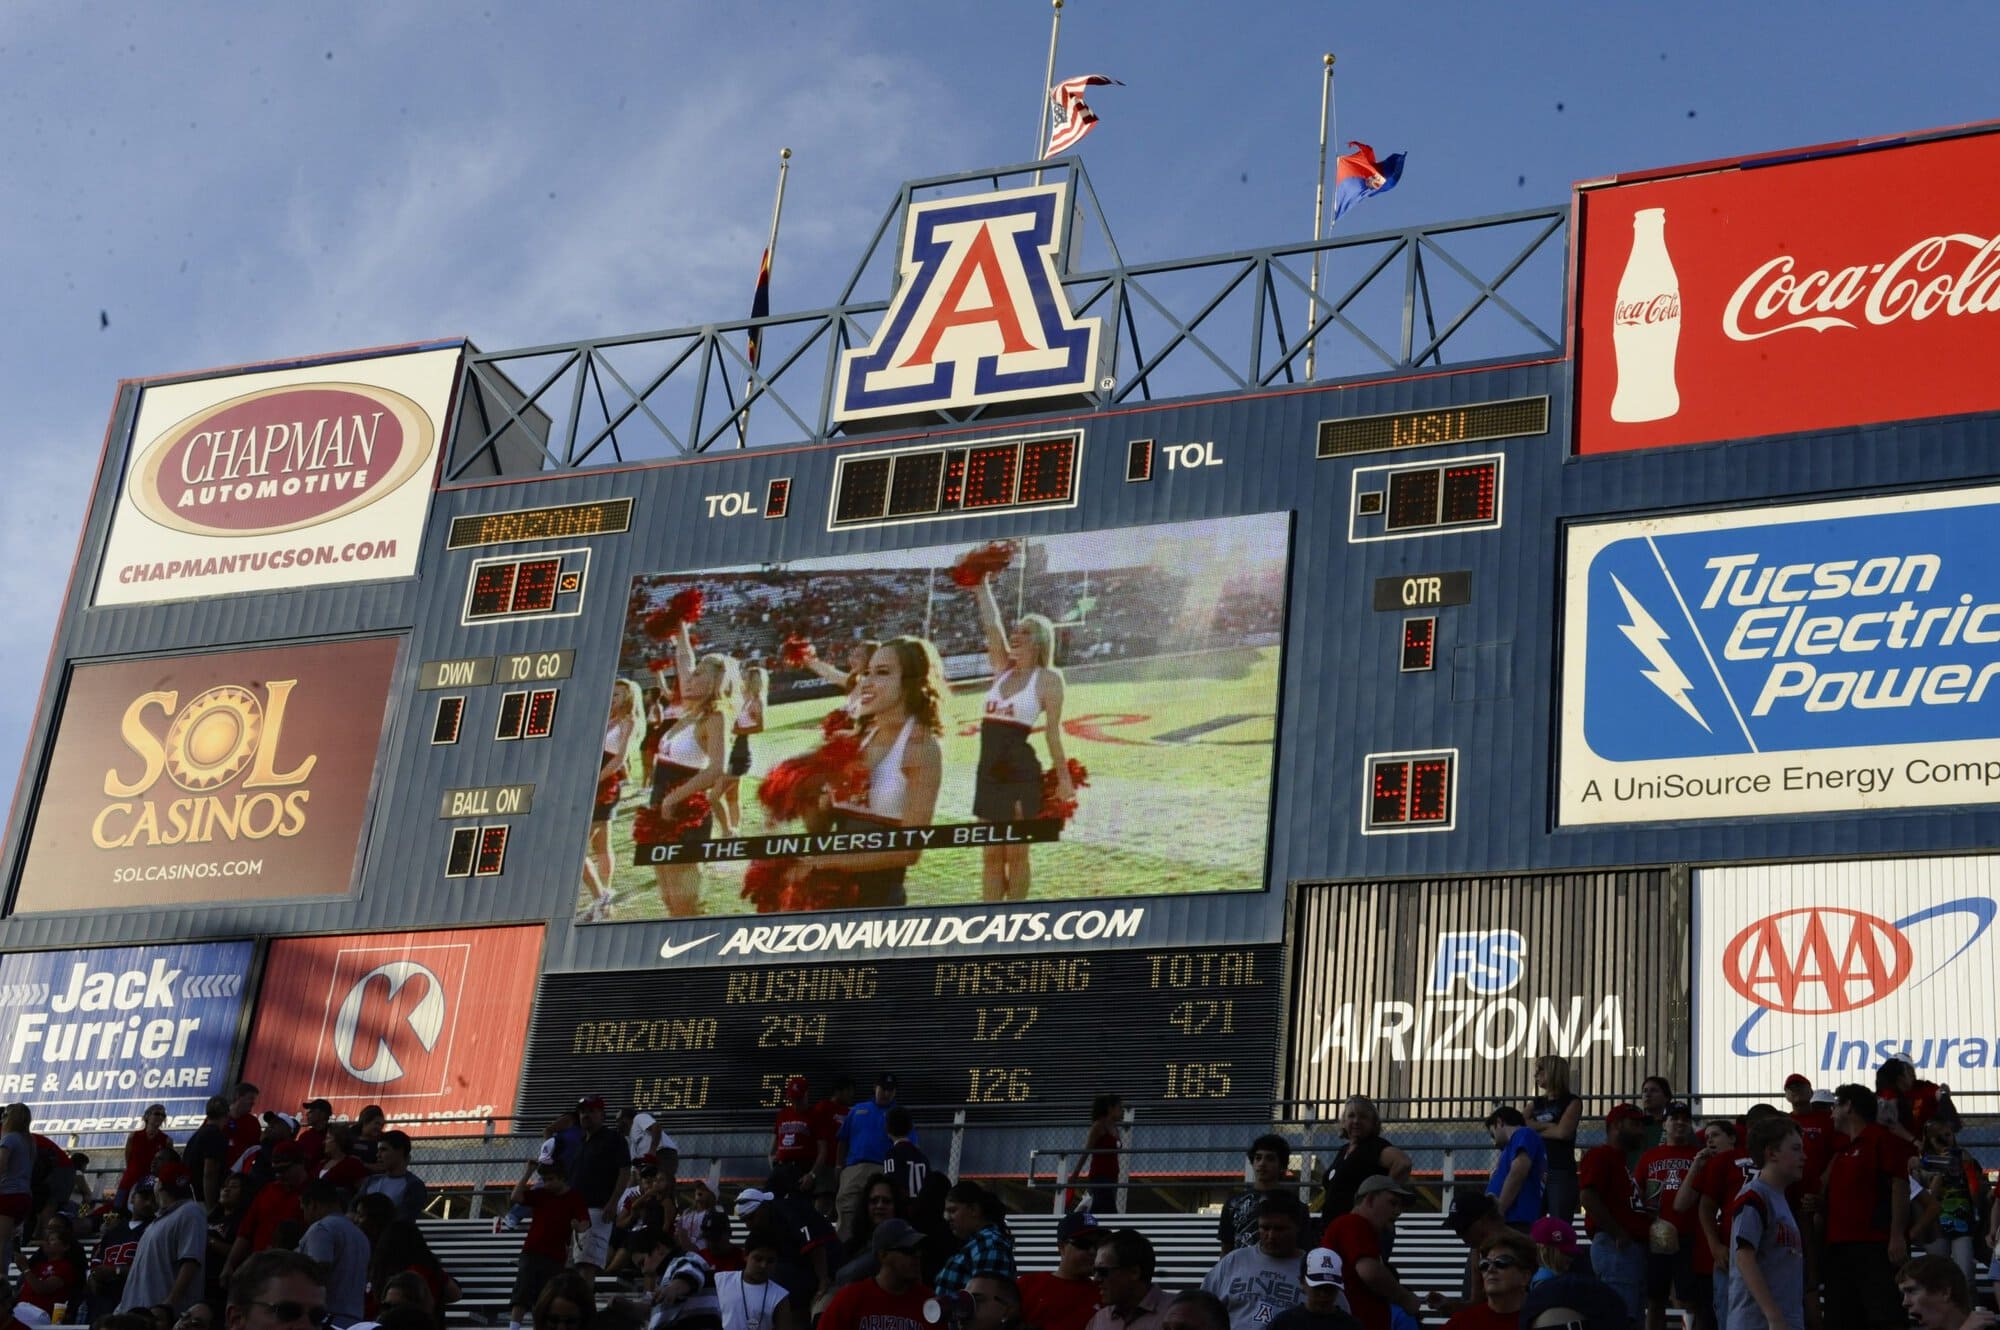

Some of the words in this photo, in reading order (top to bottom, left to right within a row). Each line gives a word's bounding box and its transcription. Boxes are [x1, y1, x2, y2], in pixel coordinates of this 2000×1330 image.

[834, 182, 1102, 422] A
[1722, 234, 2000, 341] Coca-Cola
[180, 411, 385, 485] CHAPMAN
[1393, 411, 1466, 447] WSU
[1163, 441, 1223, 469] TOL
[178, 469, 368, 508] AUTOMOTIVE
[705, 493, 758, 519] TOL
[480, 506, 604, 544] ARIZONA
[118, 539, 398, 584] CHAPMANTUCSON.COM
[1701, 554, 1941, 609] Tucson
[476, 562, 558, 612] 48
[1402, 577, 1441, 605] QTR
[1724, 594, 2000, 661] Electric
[438, 661, 475, 686] DWN
[511, 656, 531, 680] TO
[536, 653, 560, 678] GO
[1751, 662, 2000, 717] Power
[104, 679, 317, 798] SOL
[452, 788, 490, 816] BALL
[496, 787, 521, 813] ON
[1375, 761, 1447, 822] 40
[1581, 780, 1602, 803] A
[1614, 774, 1771, 801] UniSource
[1783, 766, 1894, 793] Energy
[1906, 759, 2000, 787] Comp
[92, 790, 310, 849] CASINOS
[651, 845, 683, 862] OF
[702, 841, 748, 859] THE
[766, 829, 936, 856] UNIVERSITY
[954, 825, 1034, 844] BELL.
[113, 859, 263, 884] SOLCASINOS.COM
[718, 908, 1144, 957] ARIZONAWILDCATS.COM
[726, 967, 878, 1004] RUSHING
[934, 958, 1092, 996] PASSING
[1147, 952, 1264, 989] TOTAL
[1427, 929, 1527, 996] FS
[1745, 910, 1890, 1010] AAA
[52, 959, 182, 1013] Jack
[9, 1013, 200, 1063] Furrier
[573, 1017, 718, 1054] ARIZONA
[758, 1013, 828, 1048] 294
[973, 1006, 1039, 1041] 177
[1170, 999, 1235, 1035] 471
[1311, 995, 1624, 1063] ARIZONA
[1821, 1031, 2000, 1071] Insura
[42, 1073, 59, 1092] &
[67, 1070, 137, 1092] AUTO
[143, 1067, 212, 1088] CARE
[632, 1075, 711, 1111] WSU
[966, 1067, 1033, 1103] 126
[1163, 1063, 1232, 1099] 185
[1648, 1157, 1694, 1173] ARIZON
